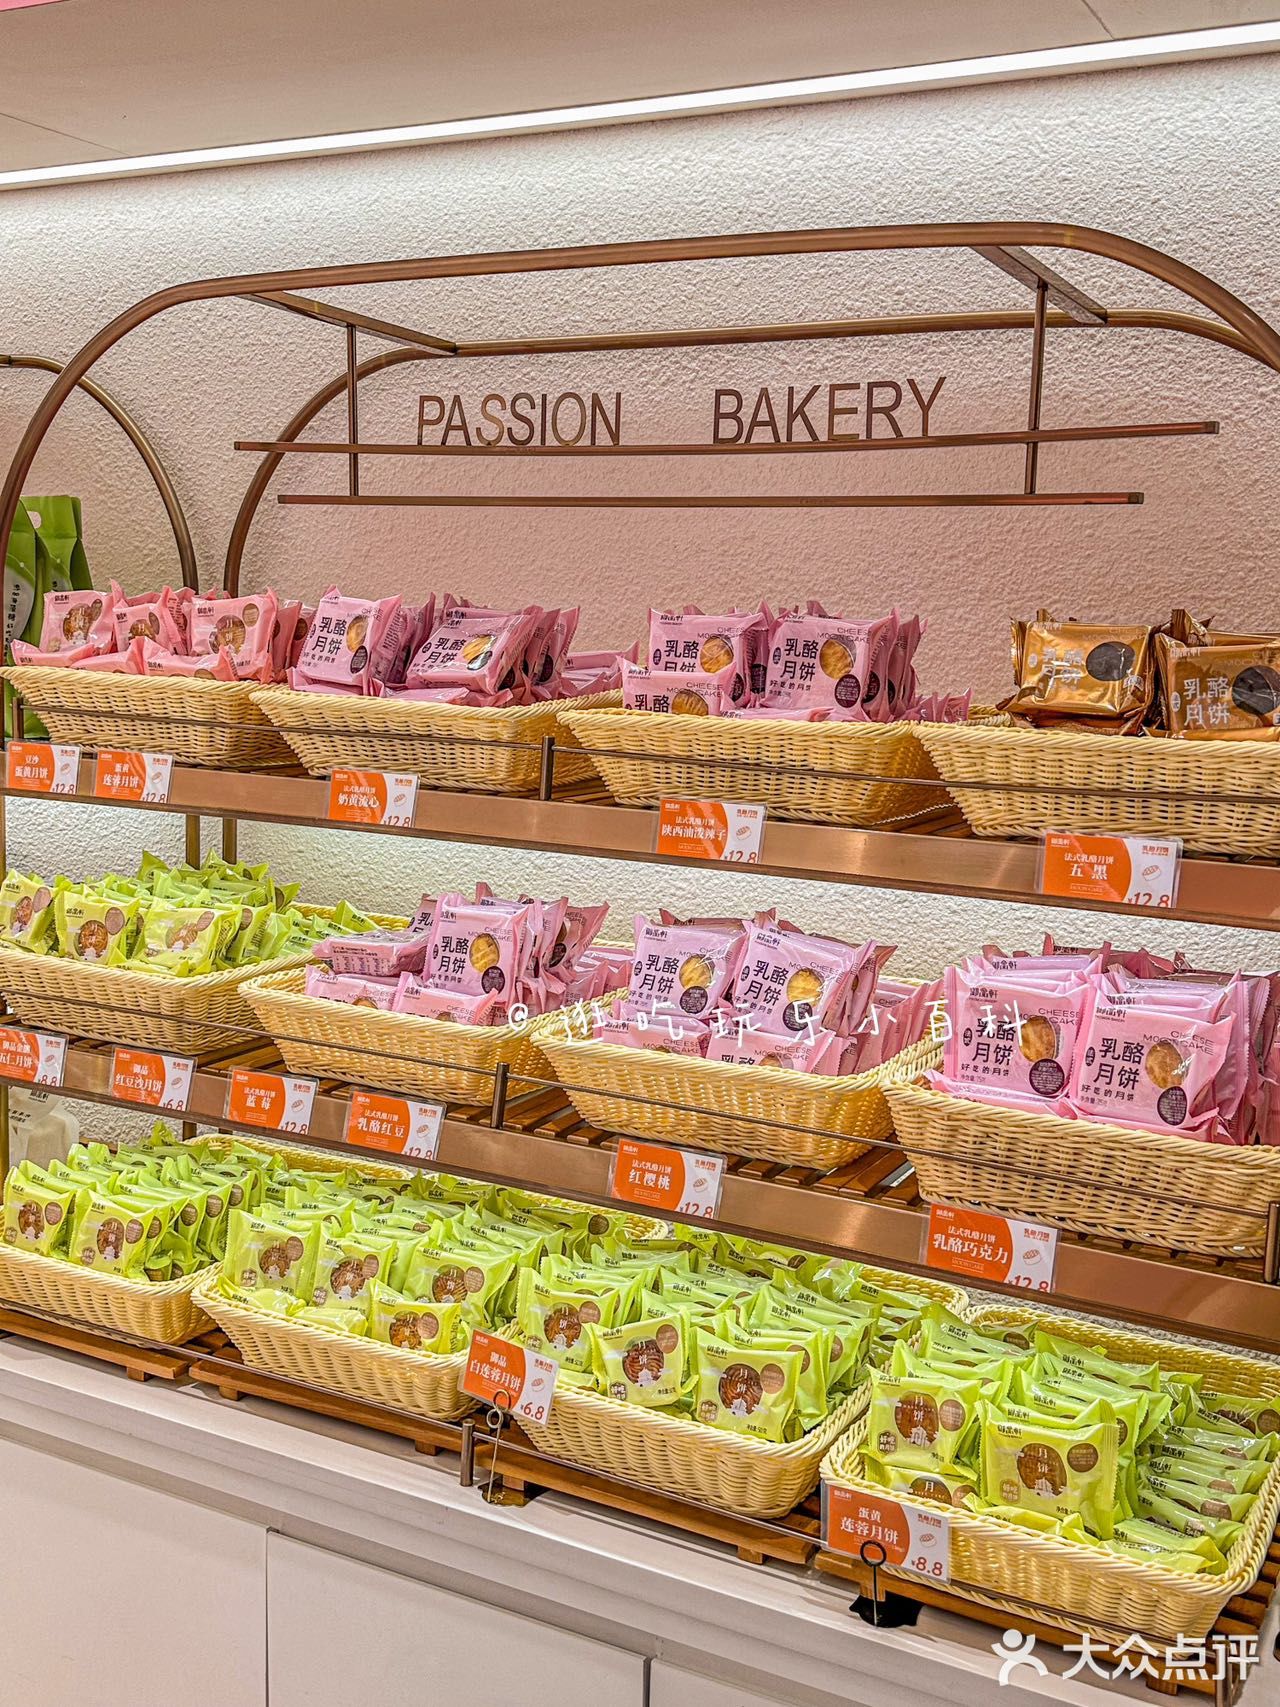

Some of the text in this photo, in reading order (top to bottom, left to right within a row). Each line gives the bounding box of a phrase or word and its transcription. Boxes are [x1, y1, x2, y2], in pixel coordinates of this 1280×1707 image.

[417, 376, 947, 446] PASSION BAKERY
[318, 616, 348, 636] 乳酪
[312, 636, 342, 656] 月饼
[434, 636, 468, 651] 乳酪
[664, 639, 699, 659] 乳酪
[784, 638, 819, 660] 乳酪
[424, 651, 458, 664] 月饼
[780, 660, 816, 682] 月饼
[1183, 676, 1230, 700] 乳酪
[634, 694, 670, 713] 乳酪
[1184, 702, 1230, 727] 月饼
[25, 755, 40, 764] 豆沙
[114, 763, 129, 773] 蛋黄
[15, 765, 49, 780] 蛋黄月饼
[102, 773, 140, 788] 莲蓉月饼
[338, 792, 380, 808] 奶黄流心
[675, 815, 715, 825] 法式乳酪月饼
[661, 823, 726, 841] 陕西油泼辣子
[1064, 852, 1114, 865] 法式乳酪月饼
[1069, 863, 1107, 880] 五黑
[440, 935, 470, 956] 乳酪
[438, 955, 466, 975] 月饼
[645, 954, 680, 975] 乳酪
[753, 959, 790, 986] 乳酪
[639, 974, 675, 995] 月饼
[743, 980, 783, 1007] 月饼
[976, 1018, 1016, 1042] 乳酪
[972, 1041, 1013, 1066] 月饼
[1099, 1037, 1145, 1065] 乳酪
[133, 1063, 149, 1075] 御品
[960, 1063, 1009, 1077] 好吃的月饼
[1093, 1063, 1140, 1090] 月饼
[115, 1073, 163, 1093] 红豆沙月饼
[1081, 1084, 1135, 1102] 好吃的月饼
[245, 1094, 272, 1110] 蓝莓
[364, 1108, 399, 1121] 法式乳酪月饼
[357, 1117, 406, 1138] 乳酪红豆
[631, 1159, 672, 1173] 法式乳酪月饼
[629, 1168, 671, 1190] 红樱桃
[947, 1225, 996, 1243] 法式乳酪月饼
[933, 1233, 1008, 1264] 乳酪巧克力
[489, 1351, 507, 1368] 御品
[469, 1359, 521, 1391] 白莲蓉月饼
[520, 1401, 545, 1420] ¥6.8
[858, 1506, 881, 1522] 蛋黄
[840, 1516, 899, 1544] 莲蓉月饼
[911, 1556, 943, 1577] ¥8.8
